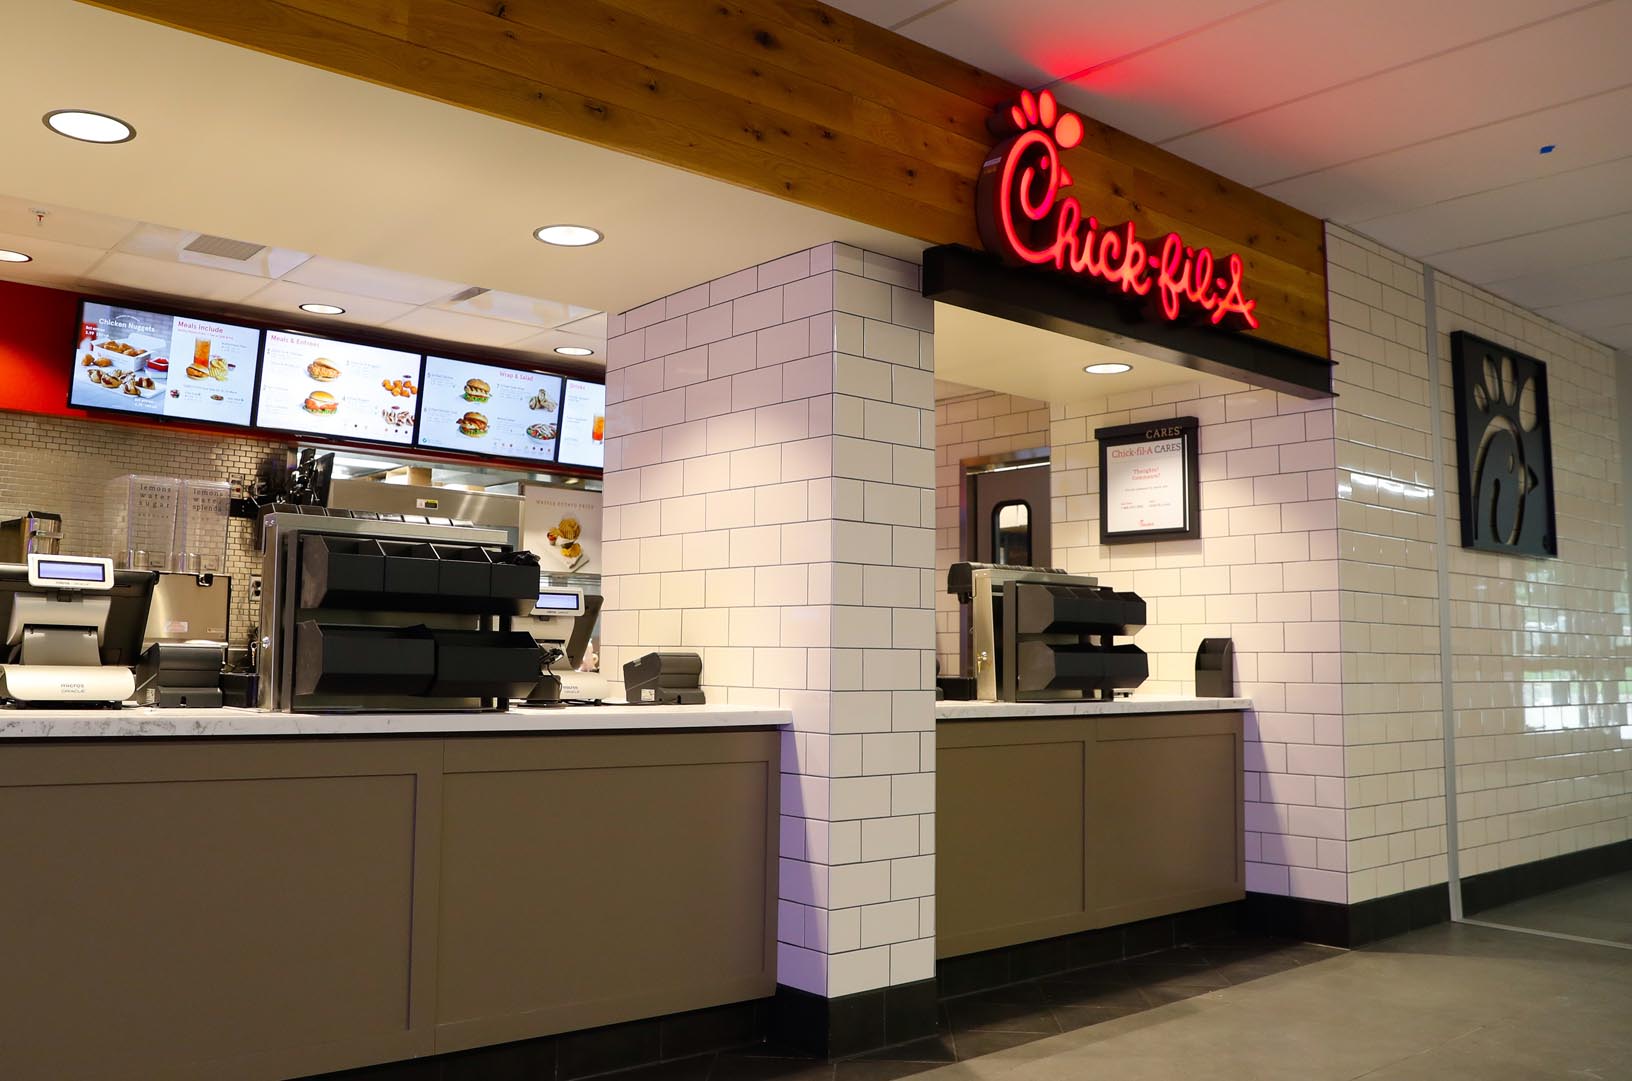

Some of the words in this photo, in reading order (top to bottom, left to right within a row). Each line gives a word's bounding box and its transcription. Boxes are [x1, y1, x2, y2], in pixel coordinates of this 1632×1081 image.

[1000, 129, 1259, 329] Chick-fil-A
[98, 318, 127, 329] Chicken
[128, 323, 155, 332] Nuggets
[177, 321, 196, 330] Meals
[1145, 427, 1181, 439] CARES
[1112, 446, 1153, 458] Chick-fil-A
[1154, 443, 1181, 454] CARES
[140, 483, 171, 492] lemons
[193, 488, 223, 497] lemons
[139, 500, 170, 509] sugar
